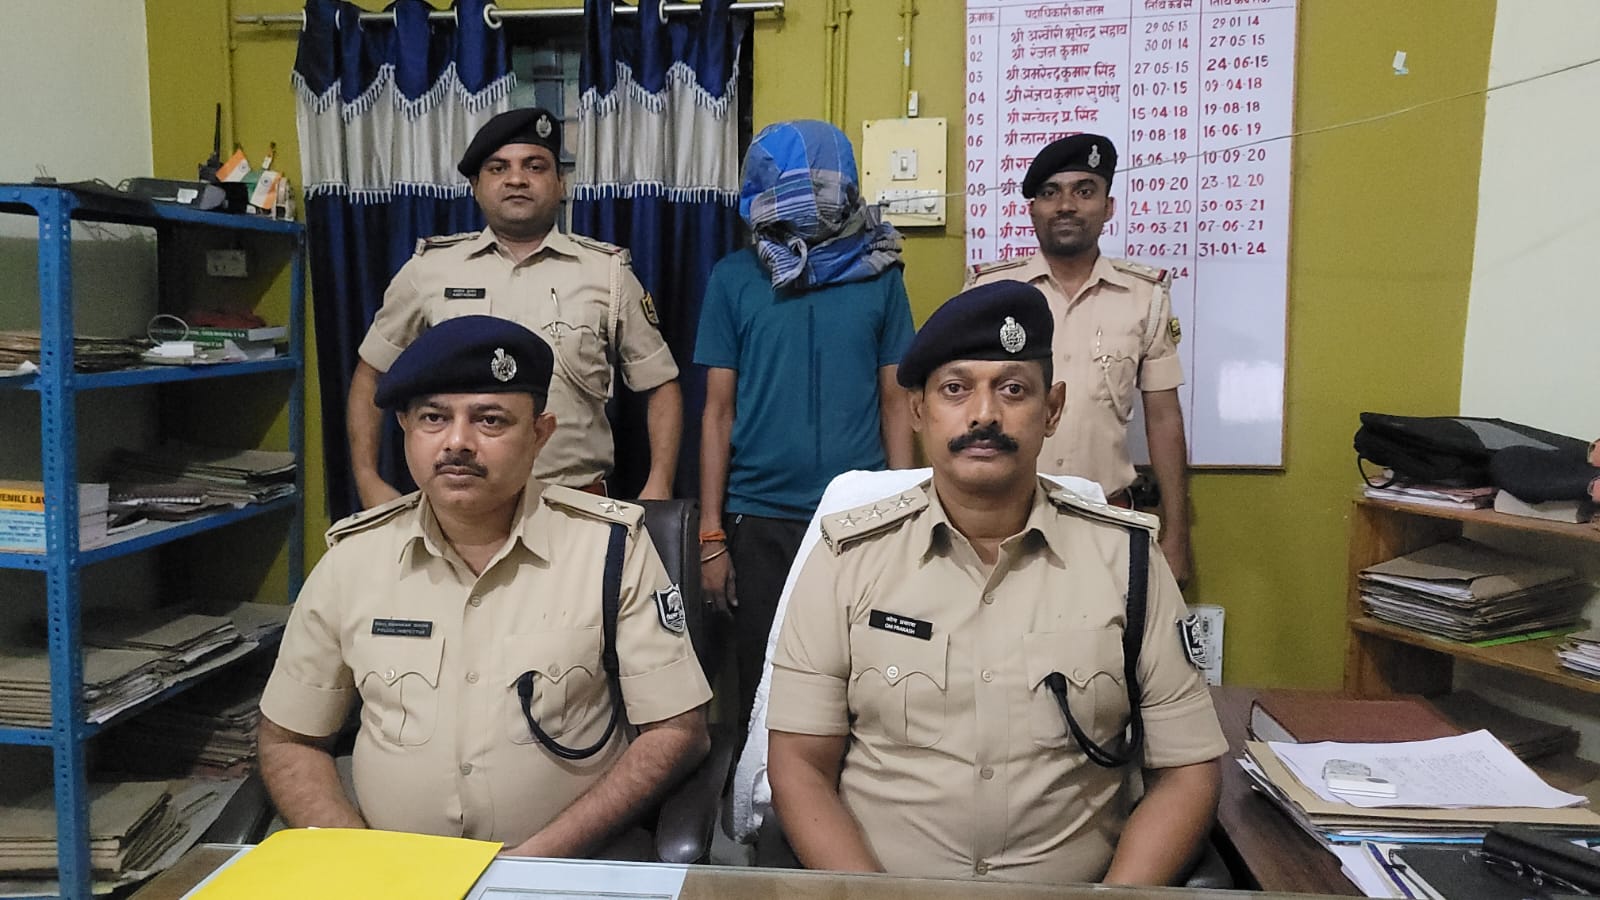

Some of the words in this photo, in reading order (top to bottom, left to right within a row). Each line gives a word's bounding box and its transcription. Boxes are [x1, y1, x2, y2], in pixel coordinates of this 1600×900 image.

[970, 34, 982, 45] 01
[1010, 27, 1025, 43] श्री
[970, 51, 983, 62] 02
[1011, 43, 1025, 60] श्री
[968, 71, 983, 83] 03
[1006, 64, 1019, 80] श्री
[969, 91, 985, 104] 04
[1005, 84, 1022, 103] श्री
[968, 113, 984, 126] 05
[1007, 107, 1019, 125] श्री
[967, 135, 983, 147] 06
[1004, 129, 1018, 146] श्री
[967, 159, 984, 173] 07
[1000, 154, 1015, 173] श्री
[967, 183, 986, 197] 08
[970, 203, 987, 217] 09
[971, 227, 986, 239] 10
[971, 248, 983, 260] 11
